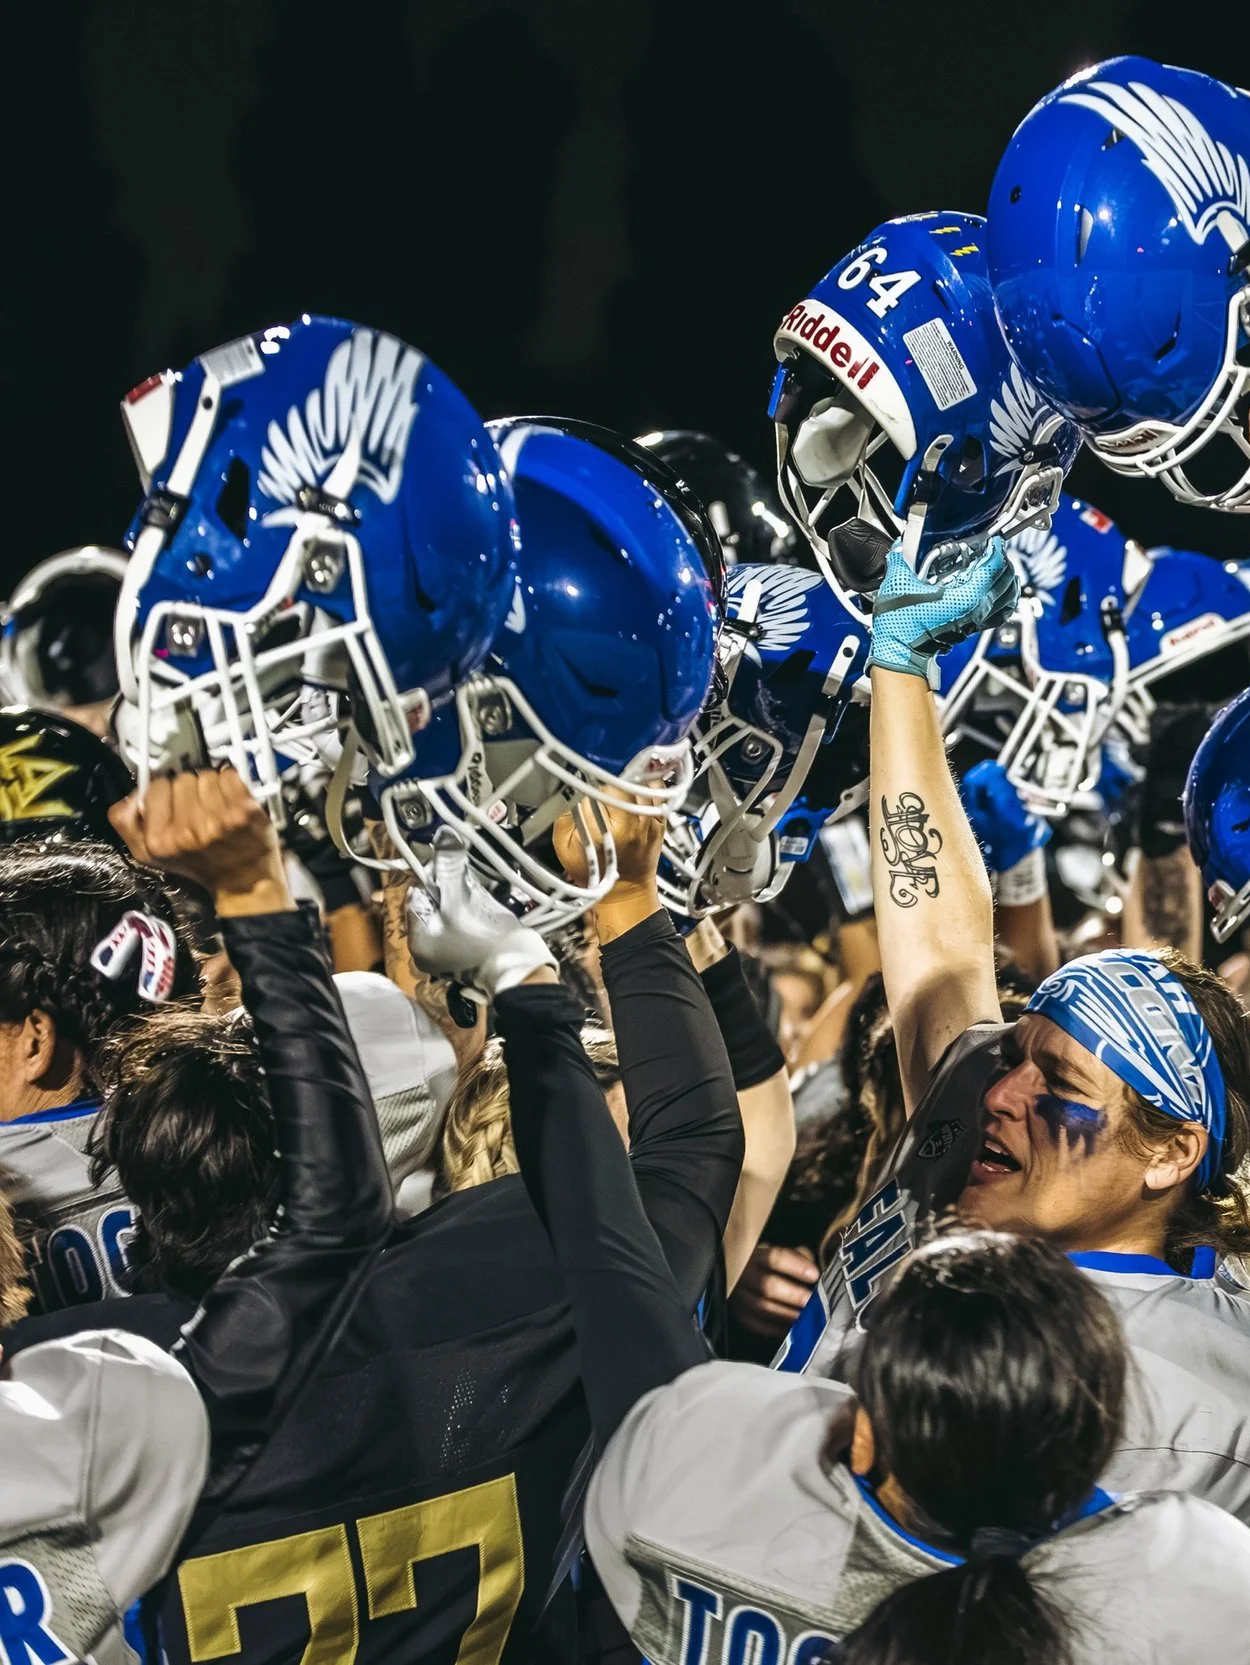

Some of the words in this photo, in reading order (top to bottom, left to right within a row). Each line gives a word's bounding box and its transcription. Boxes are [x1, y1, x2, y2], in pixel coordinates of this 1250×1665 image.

[837, 247, 922, 319] 64
[780, 304, 880, 390] Riddell
[840, 1176, 914, 1330] FAL
